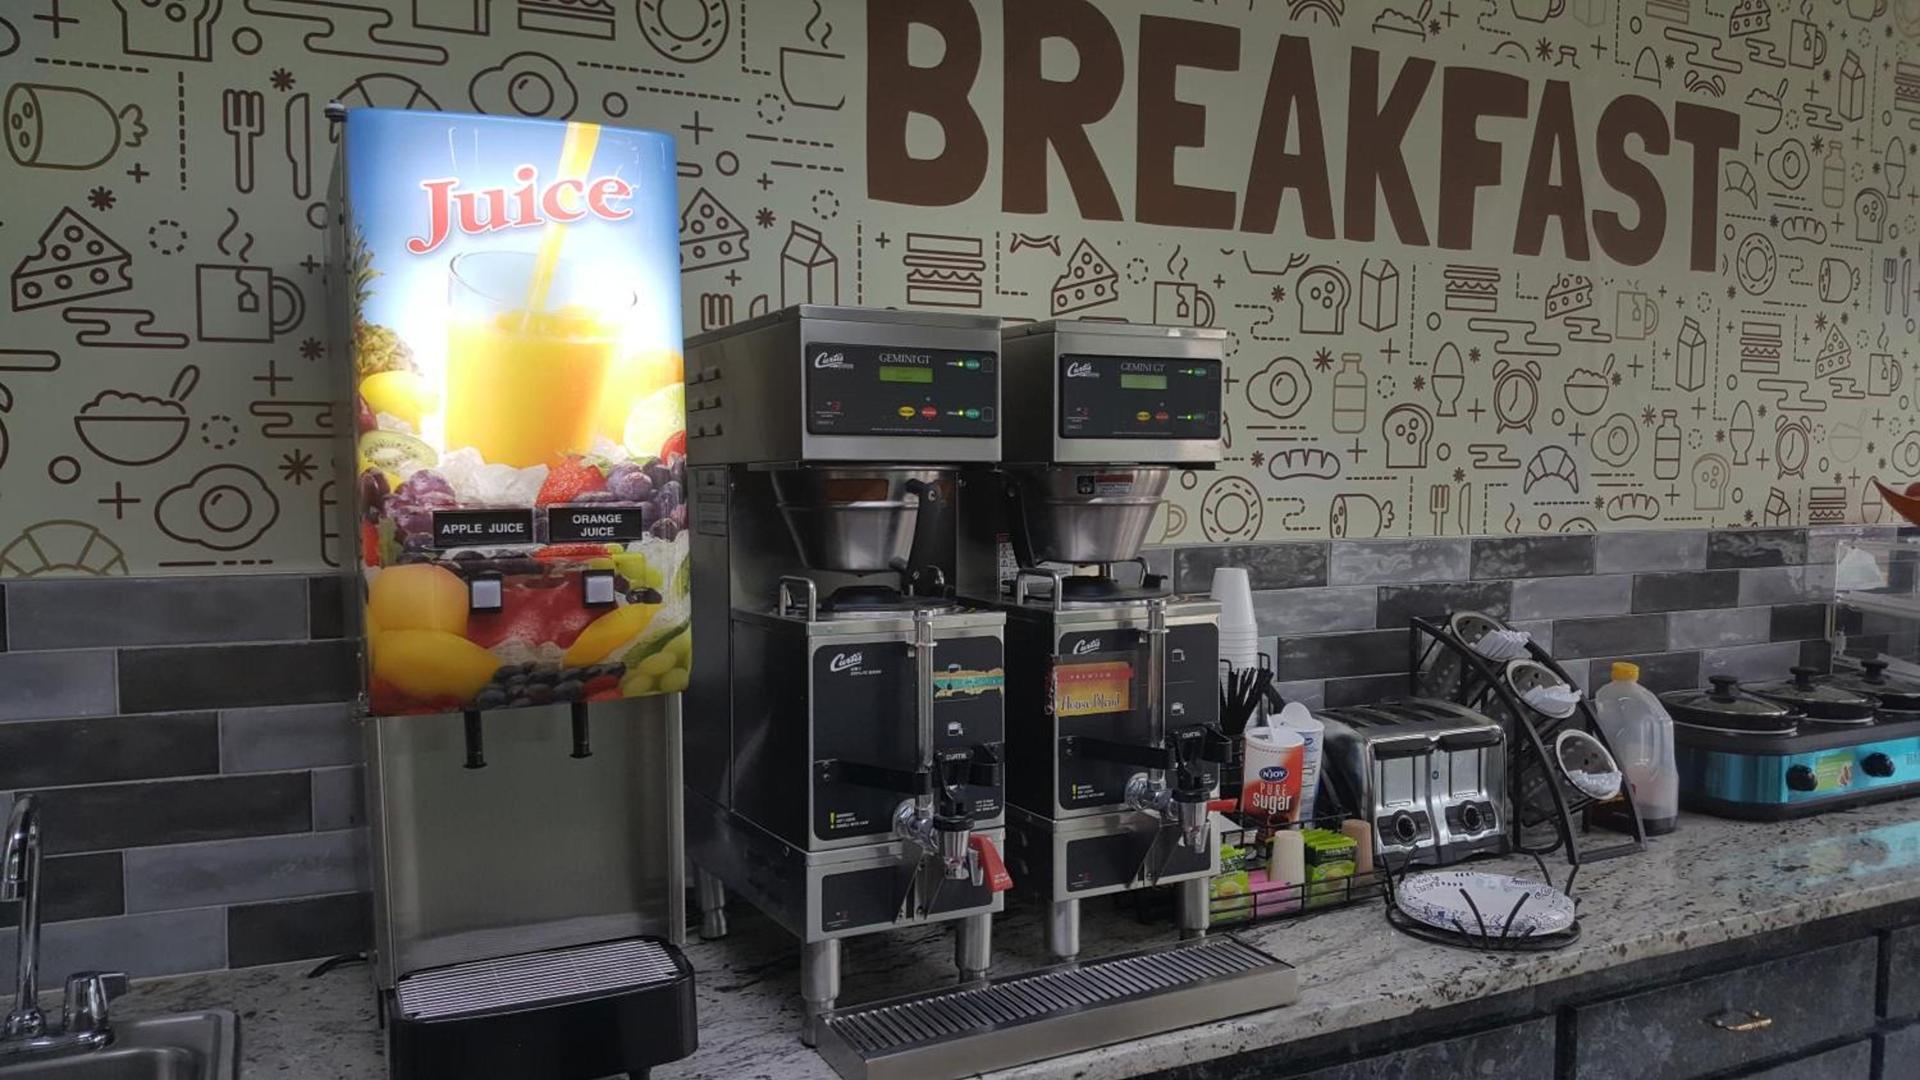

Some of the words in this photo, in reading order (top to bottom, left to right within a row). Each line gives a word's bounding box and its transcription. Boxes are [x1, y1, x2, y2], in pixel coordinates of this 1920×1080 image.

[866, 0, 1741, 273] BREAKFAST
[407, 165, 634, 255] Juice
[815, 351, 844, 369] Curtis
[572, 513, 623, 525] ORANGE
[442, 523, 483, 535] APPLE
[488, 522, 524, 534] JUICE
[580, 526, 615, 538] JUICE
[830, 652, 863, 672] Curtis
[1260, 782, 1287, 796] PURE
[1252, 792, 1292, 814] sugar
